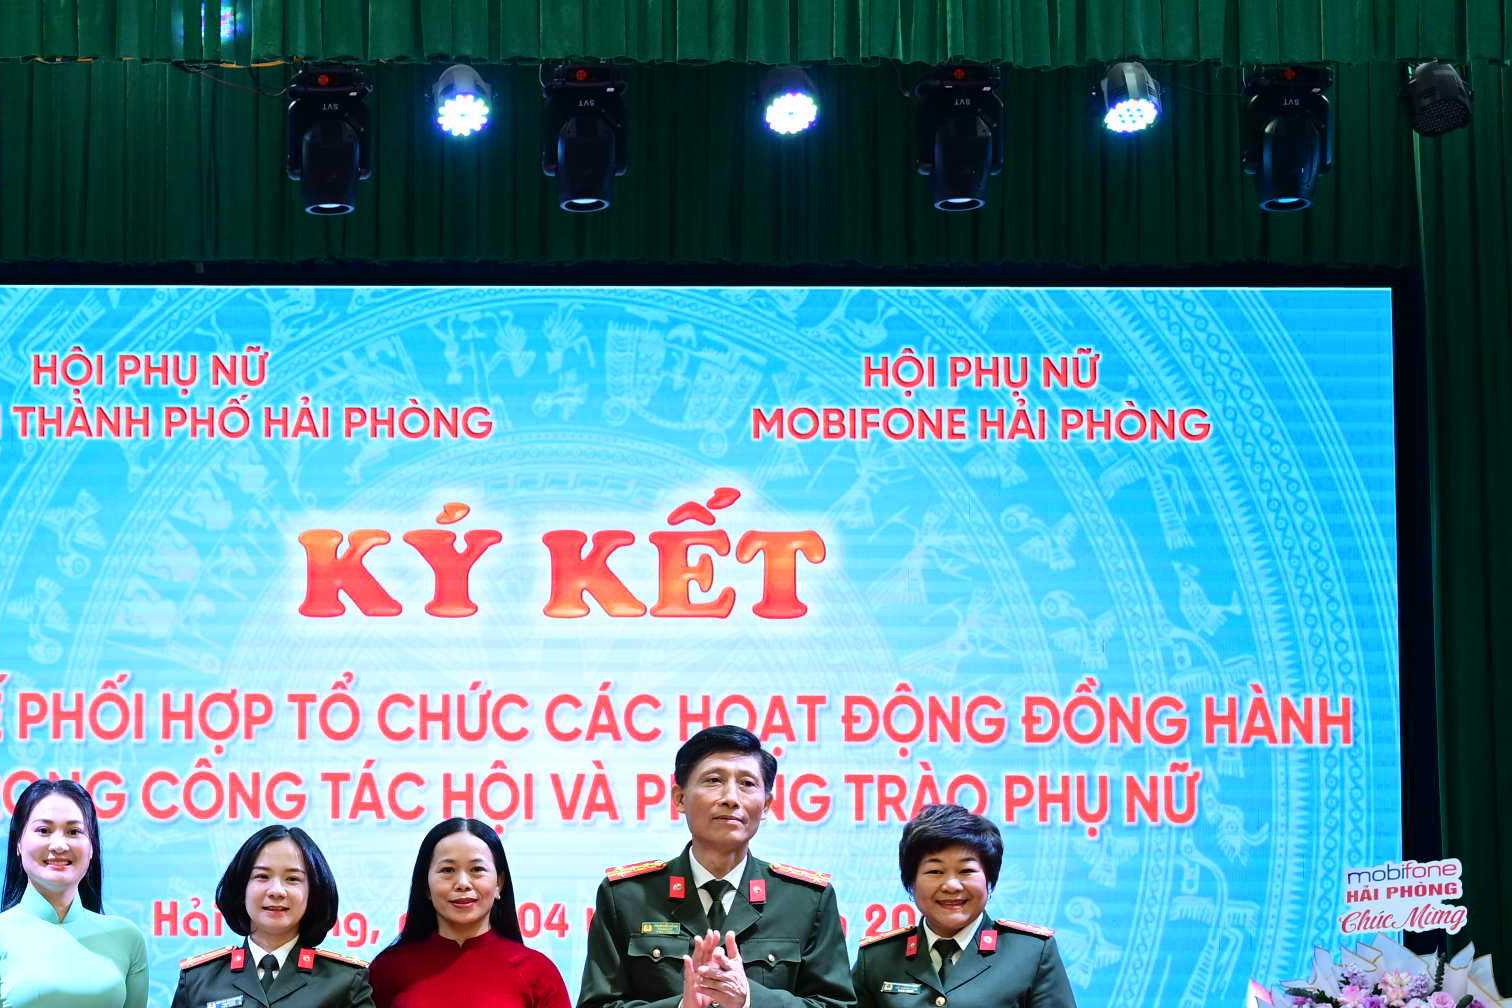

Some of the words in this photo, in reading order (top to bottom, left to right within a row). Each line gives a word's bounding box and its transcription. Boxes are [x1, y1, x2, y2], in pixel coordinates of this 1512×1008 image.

[33, 346, 103, 395] HỘI
[118, 354, 198, 396] PHỤ
[212, 345, 269, 387] NỮ
[864, 348, 935, 397] HỘI
[950, 356, 1029, 398] PHỤ
[1043, 348, 1101, 389] NỮ
[13, 398, 150, 438] THÀNH
[164, 394, 250, 439] PHỐ
[264, 395, 330, 439] HẢI
[344, 400, 494, 439] PHÒNG
[752, 407, 967, 441] MOBIFONE
[980, 399, 1046, 441] HẢI
[1061, 401, 1211, 441] PHÒNG
[298, 502, 503, 619] KÝ
[541, 487, 827, 620] KẾT
[18, 674, 144, 741] PHỐI
[161, 688, 274, 759] HỢP
[287, 671, 361, 742] TỔ
[377, 680, 529, 742] CHỨC
[544, 681, 662, 743] CÁC
[679, 693, 827, 758] HOẠT
[840, 681, 1006, 758] ĐỘNG
[1021, 677, 1188, 745] ĐỒNG
[1204, 683, 1352, 745] HÀNH
[141, 757, 307, 820] CÔNG
[320, 758, 425, 821] TÁC
[442, 759, 534, 835] HỘI
[550, 760, 619, 821] VÀ
[843, 761, 988, 822] TRÀO
[1004, 774, 1109, 838] PHỤ
[1126, 761, 1201, 824] NỮ
[1346, 885, 1380, 904] HẢI
[1385, 881, 1458, 900] PHÒNG
[1347, 863, 1457, 884] mobifone
[153, 897, 223, 937] Hải
[517, 901, 569, 939] 04
[1340, 909, 1398, 933] Chúc
[1400, 903, 1465, 930] Mừng
